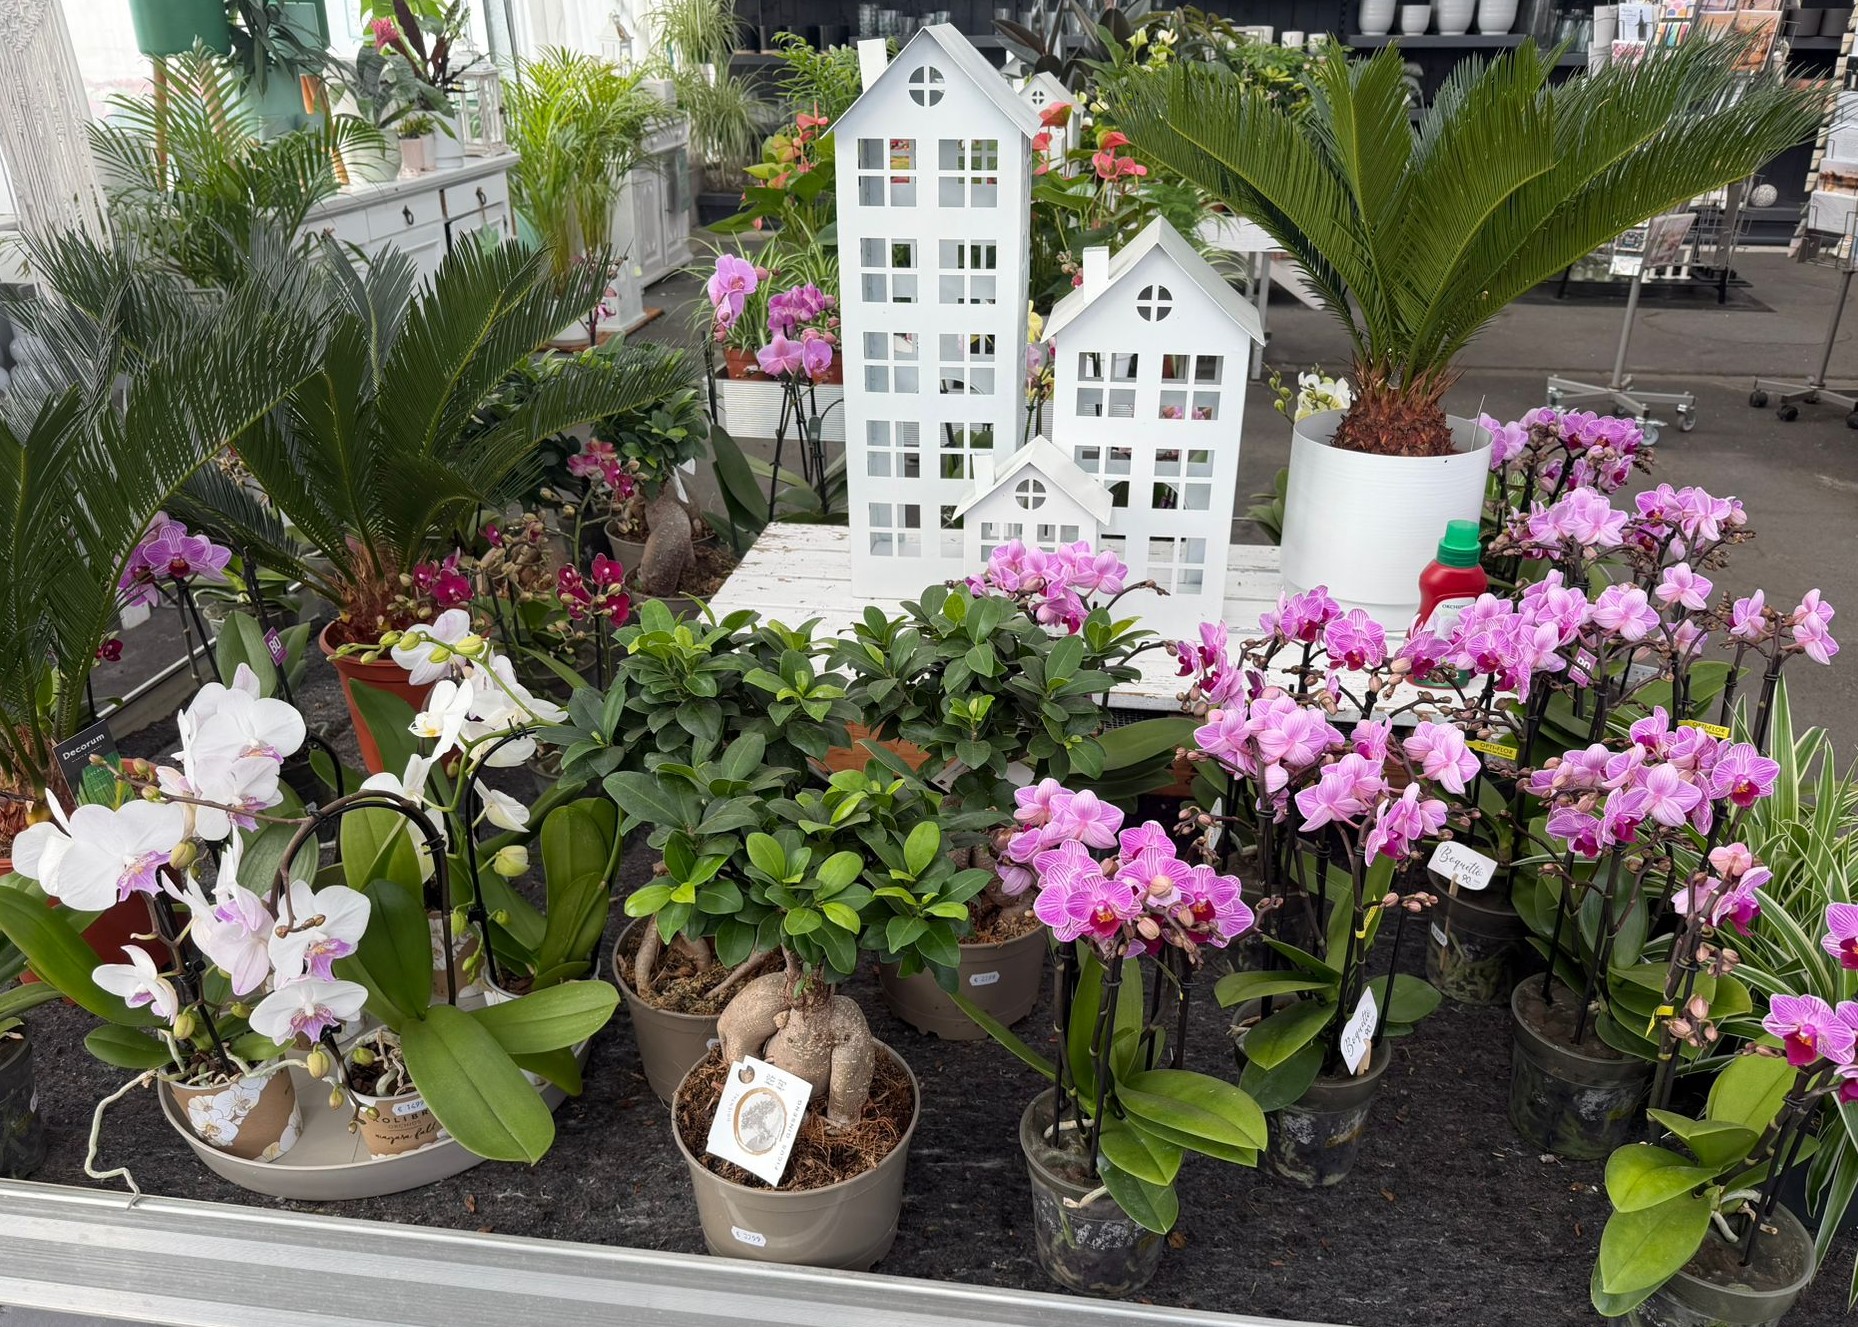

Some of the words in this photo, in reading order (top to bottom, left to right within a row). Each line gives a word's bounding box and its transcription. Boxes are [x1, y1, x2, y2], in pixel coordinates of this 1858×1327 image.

[62, 733, 105, 760] Decorum
[1480, 742, 1514, 755] OPTI-FLOR
[775, 1145, 787, 1170] FICUS
[786, 1100, 802, 1139] GINSENG
